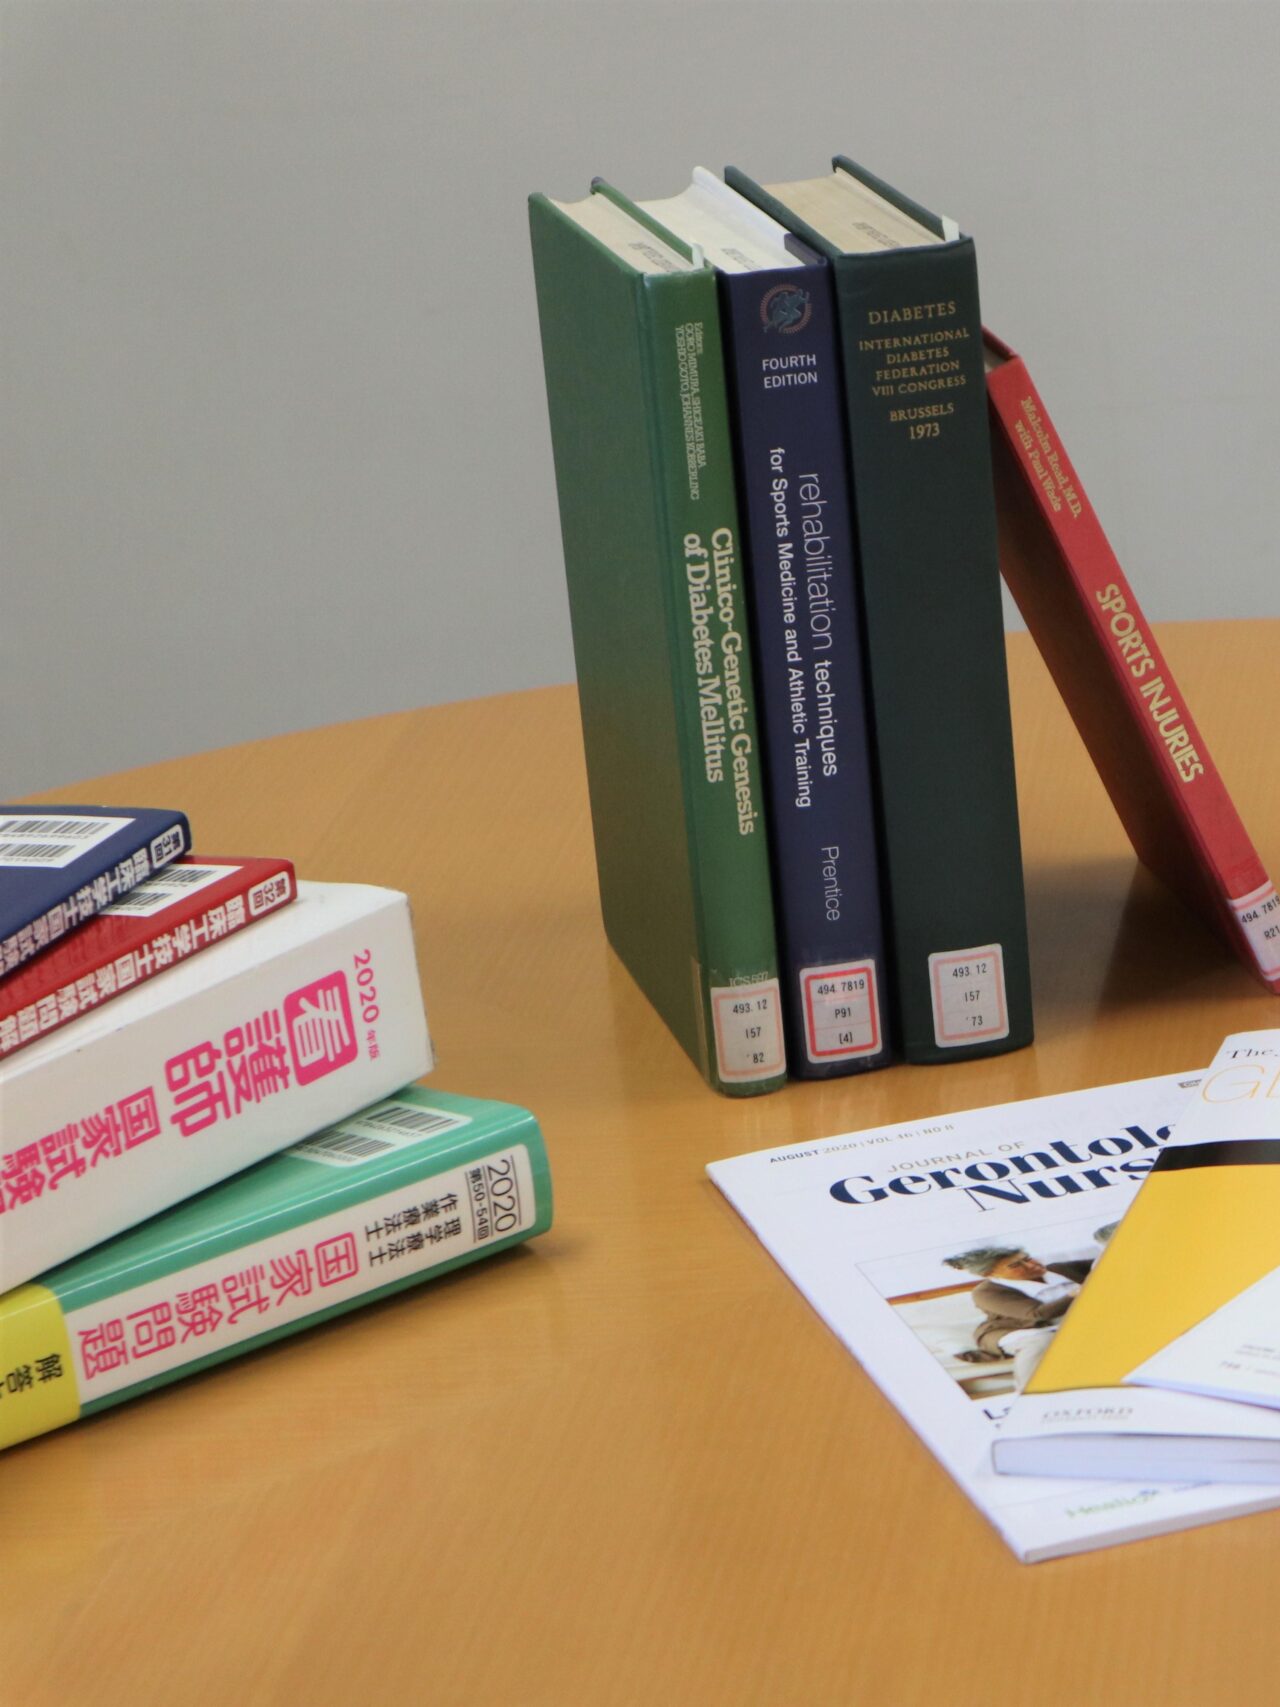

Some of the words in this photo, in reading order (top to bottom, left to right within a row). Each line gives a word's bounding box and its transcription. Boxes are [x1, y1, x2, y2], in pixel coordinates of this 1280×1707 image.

[868, 301, 957, 325] DIABETES
[762, 354, 817, 371] FOURTH
[859, 327, 970, 351] INTERNATIONAL
[886, 347, 950, 364] DIABETES
[763, 371, 818, 389] EDITION
[872, 384, 895, 397] VIII
[898, 374, 966, 394] CONGRESS
[876, 360, 960, 381] FEDERATION
[890, 403, 955, 422] BRUSSELS
[909, 424, 940, 440] 1973
[1021, 395, 1051, 454] Malcolm
[770, 447, 785, 473] for
[1015, 419, 1033, 450] with
[1029, 448, 1048, 480] Paul
[770, 478, 791, 538] Sports
[683, 533, 709, 558] of
[799, 473, 836, 650] rehabilitation
[778, 543, 798, 624] Medicine
[686, 561, 715, 675] Diabetes
[785, 629, 803, 662] and
[788, 668, 808, 734] Athletic
[1096, 582, 1155, 679] SPORTS
[1139, 675, 1204, 784] INJURIES
[697, 675, 727, 783] Mellitus
[813, 660, 837, 777] techniques
[731, 733, 758, 835] Genesis
[794, 738, 813, 808] Training
[821, 846, 841, 921] Prentice
[835, 1008, 852, 1019] P91
[1228, 1047, 1275, 1059] The
[770, 1149, 820, 1164] AUGUST
[887, 1147, 996, 1173] JOURNAL
[998, 1141, 1026, 1154] OF
[365, 1192, 458, 1242] 作業療法士
[469, 1167, 490, 1241] 第50-54回
[487, 1159, 517, 1233] 2020
[369, 1219, 462, 1267] 理学療法士
[78, 1232, 359, 1381] 国家試験問題
[0, 1353, 63, 1399] 解答
